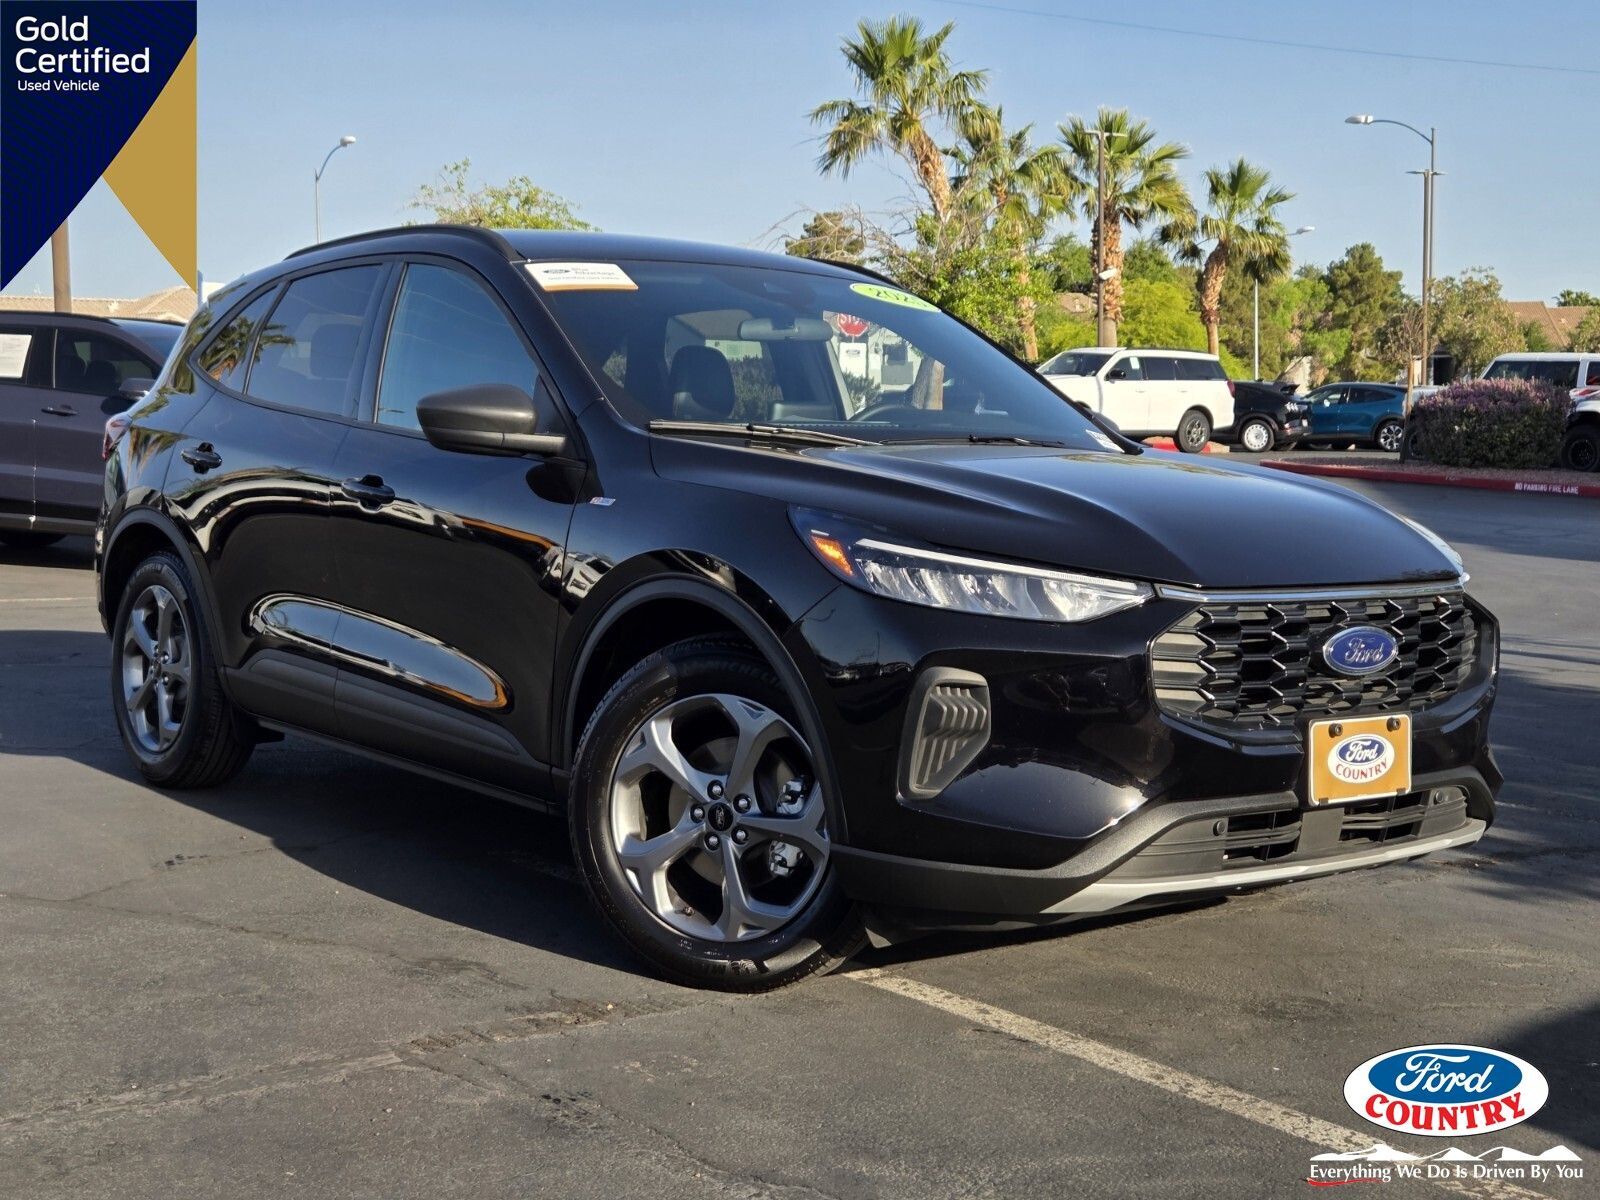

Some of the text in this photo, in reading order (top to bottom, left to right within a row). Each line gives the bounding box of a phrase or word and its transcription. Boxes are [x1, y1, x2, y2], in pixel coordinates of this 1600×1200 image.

[1514, 482, 1523, 491] NO
[1563, 486, 1579, 495] LANE
[1344, 637, 1385, 663] Ford
[1345, 739, 1379, 762] Ford
[1335, 760, 1387, 780] COUNTRY
